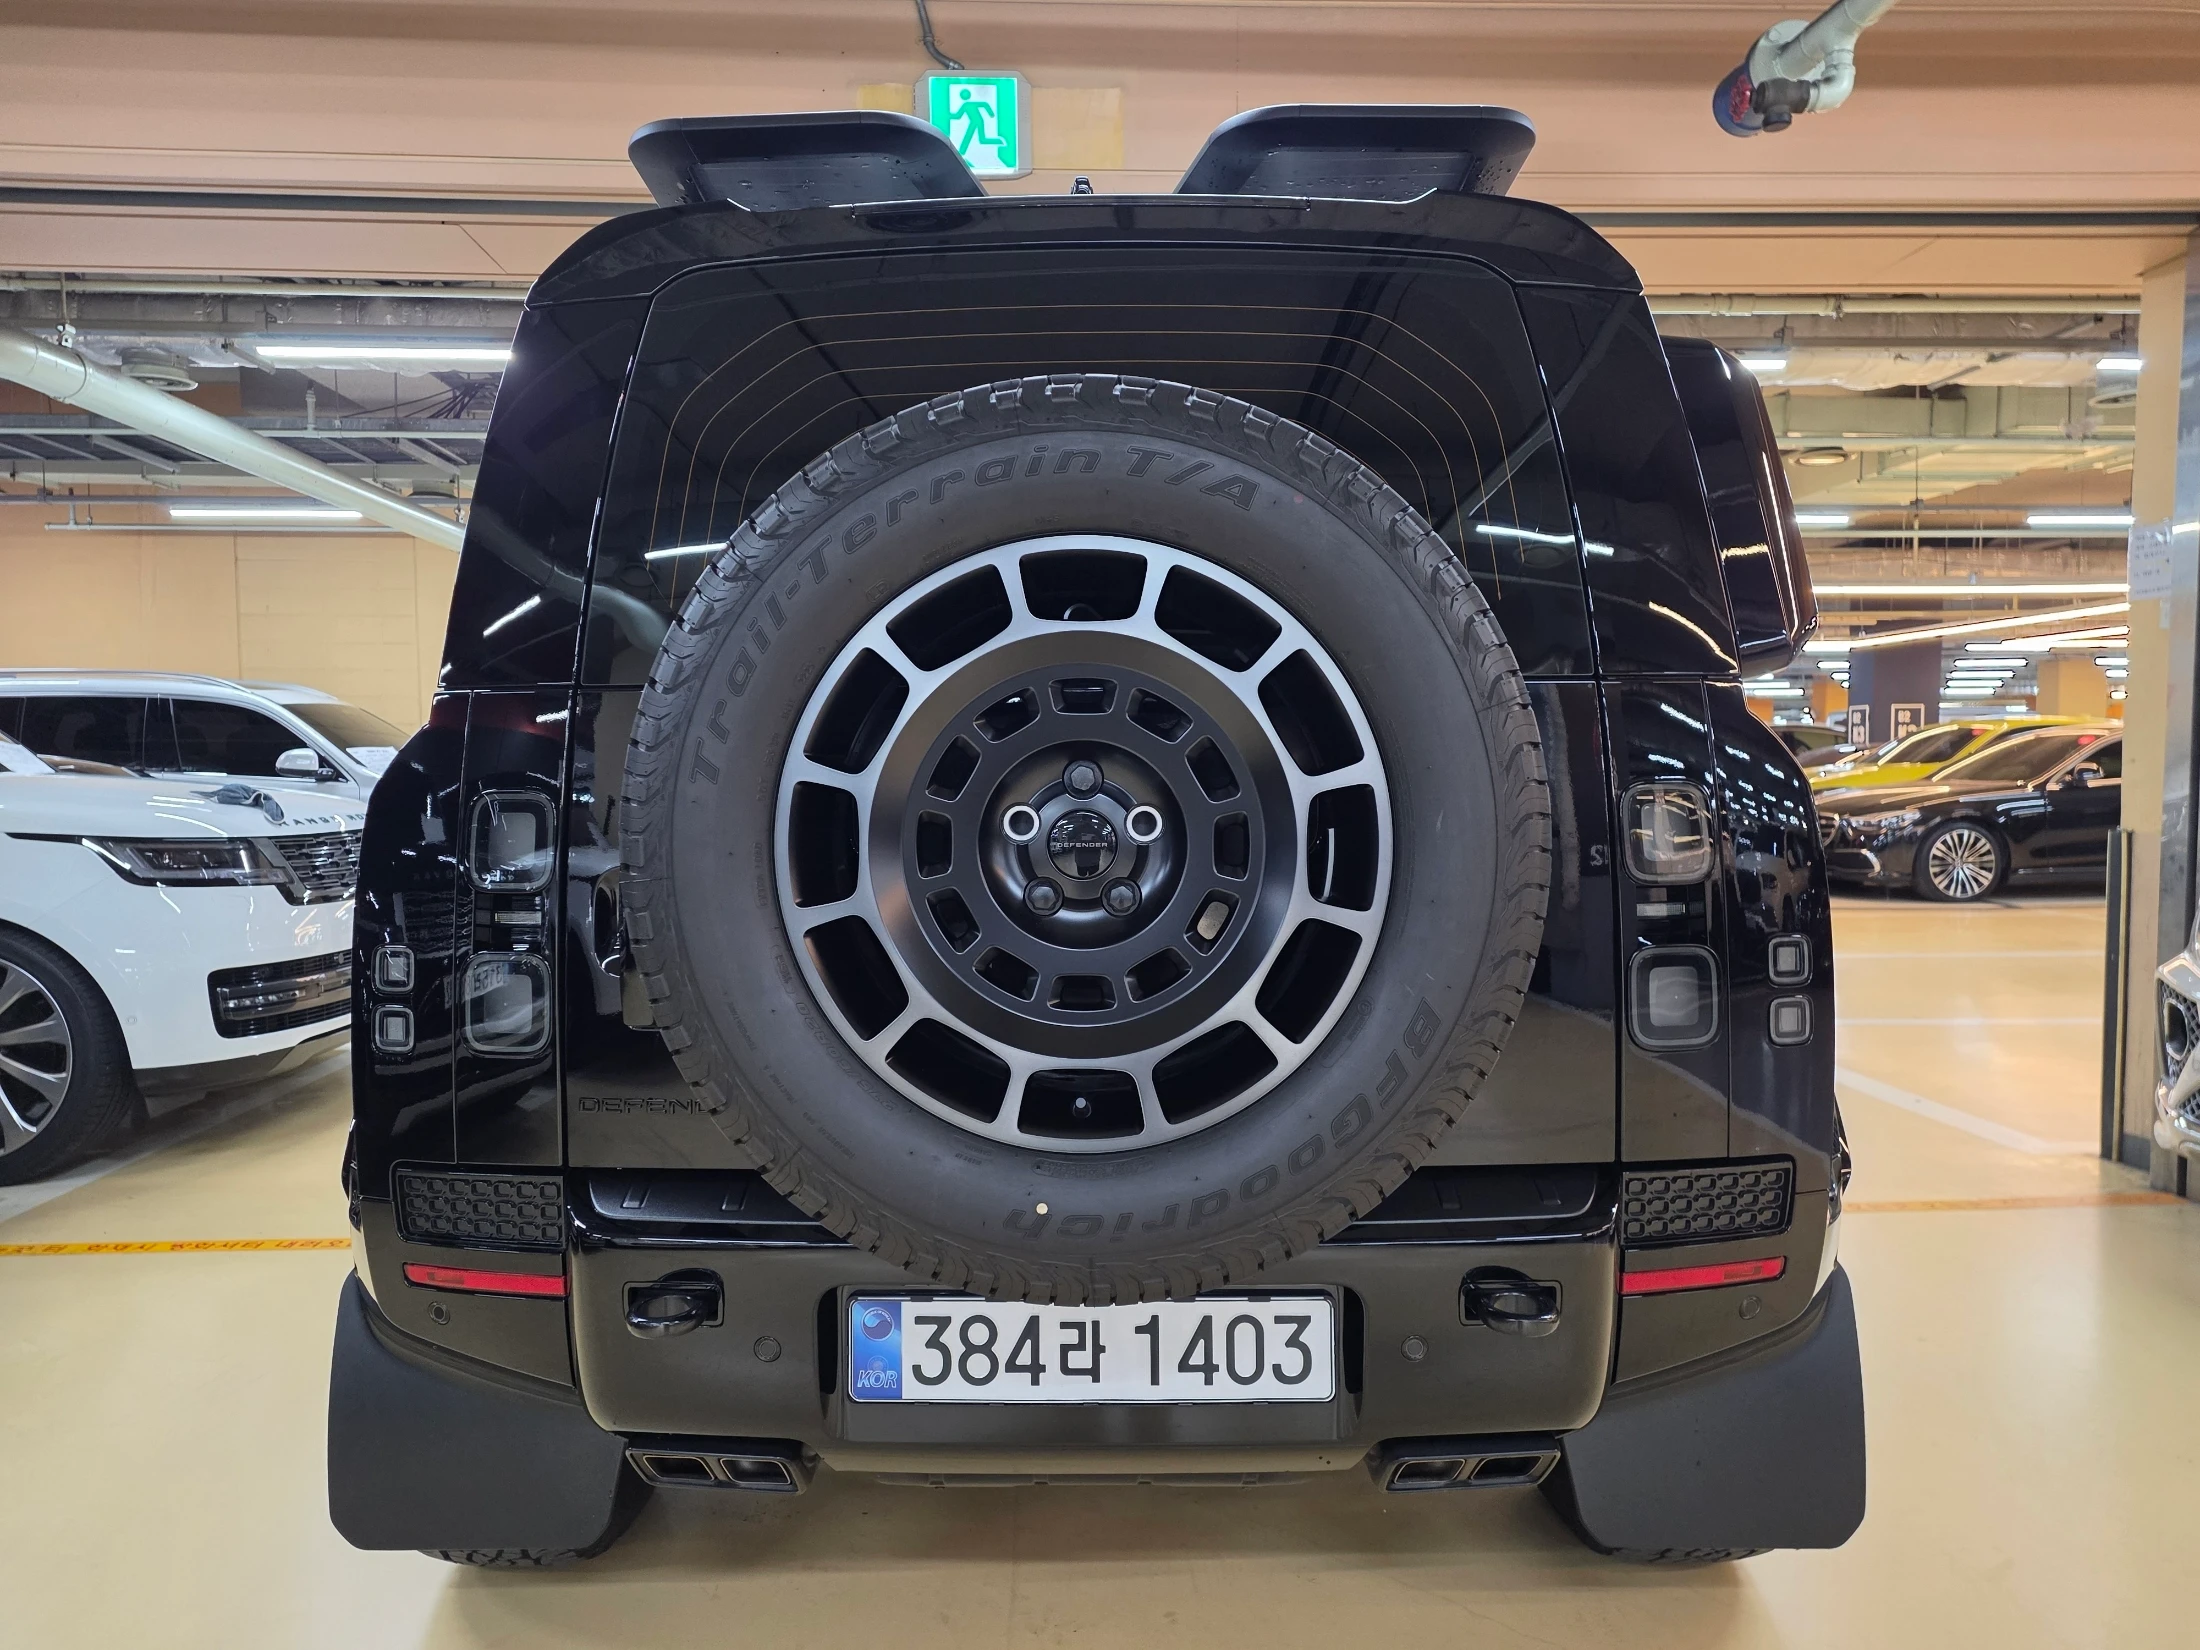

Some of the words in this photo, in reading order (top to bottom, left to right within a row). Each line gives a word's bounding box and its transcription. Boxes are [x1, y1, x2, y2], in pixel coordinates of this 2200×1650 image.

[688, 442, 1101, 785] Trail-Terrain
[1123, 444, 1262, 512] T/A
[998, 995, 1449, 1243] BFGoodrich
[857, 1370, 897, 1388] KOR
[912, 1314, 1106, 1386] 384라
[1134, 1314, 1313, 1386] 1403
